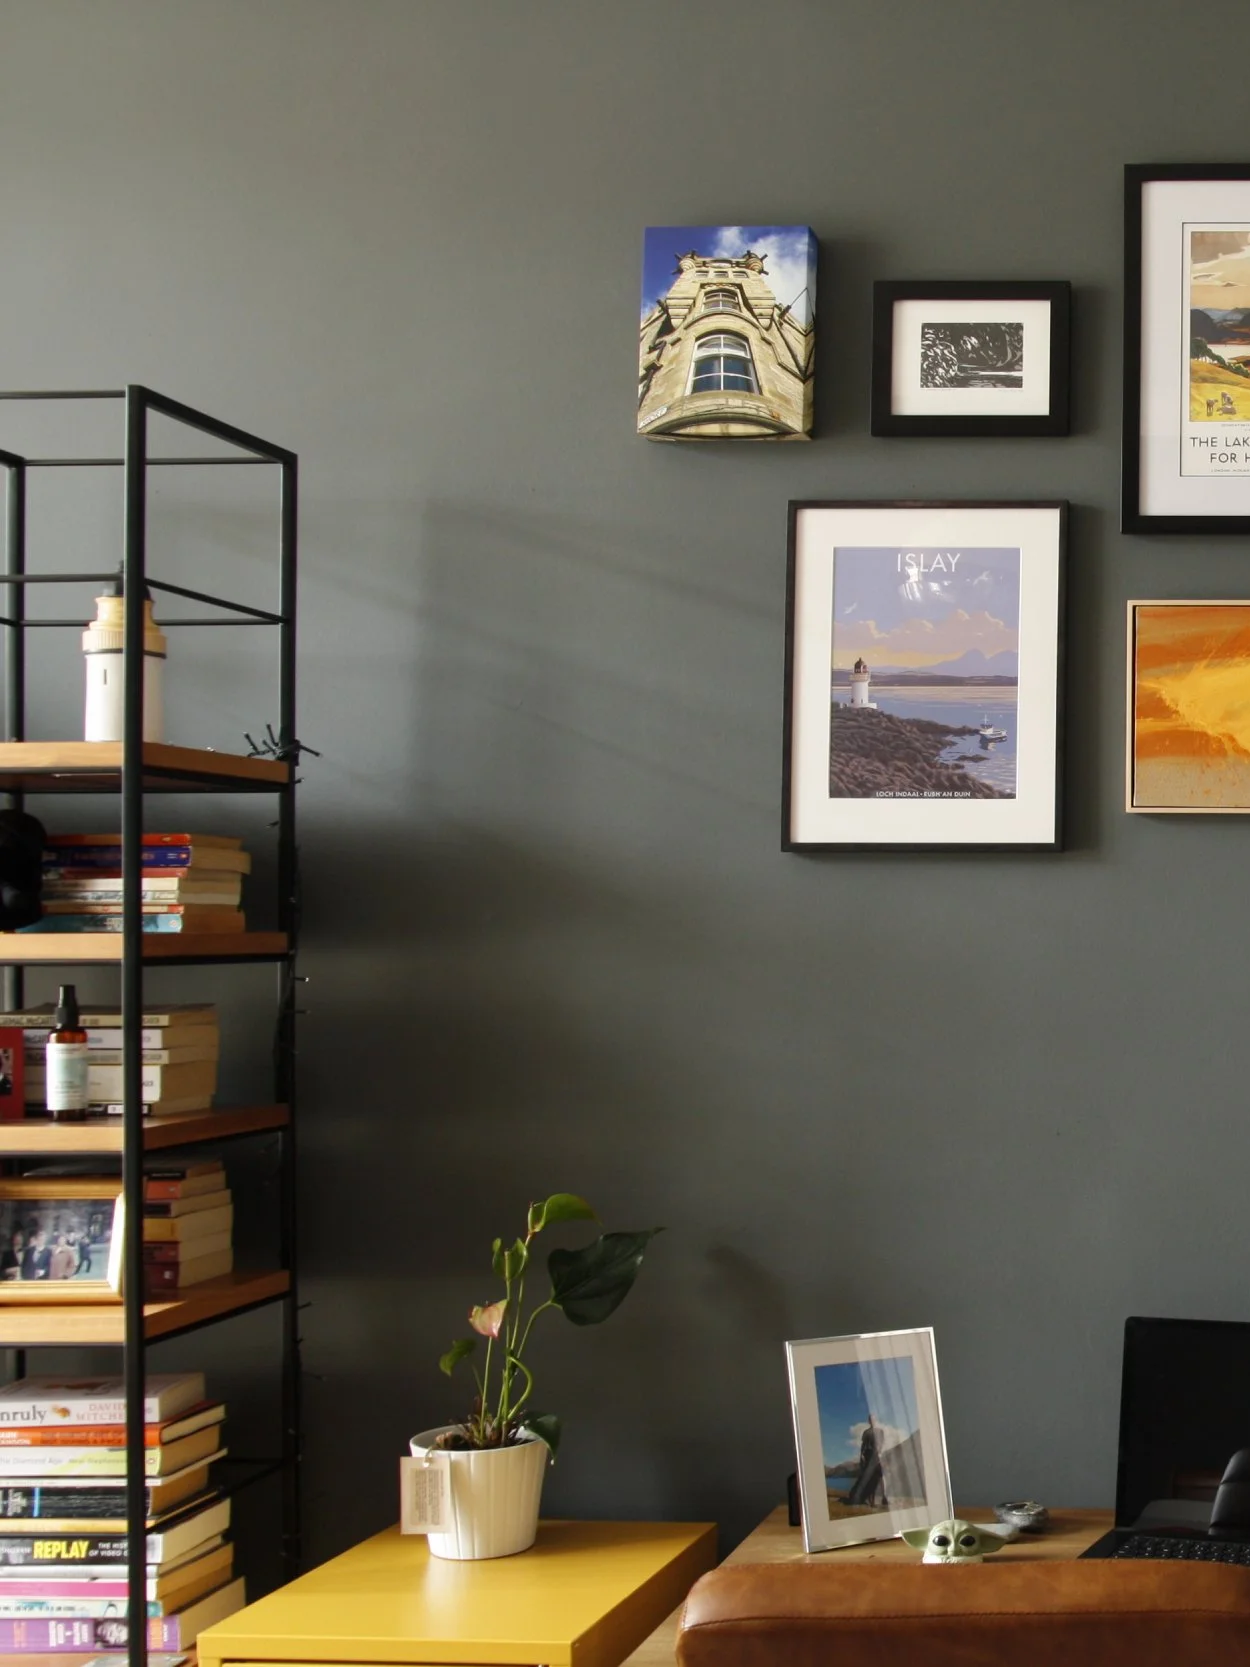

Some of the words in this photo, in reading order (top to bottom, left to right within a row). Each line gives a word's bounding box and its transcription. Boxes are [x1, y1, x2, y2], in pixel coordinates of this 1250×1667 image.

[1189, 437, 1218, 447] THE
[1210, 453, 1238, 464] FOR
[897, 553, 961, 573] ISLAY
[88, 1402, 127, 1412] DAVID
[32, 1540, 89, 1560] REPLAY
